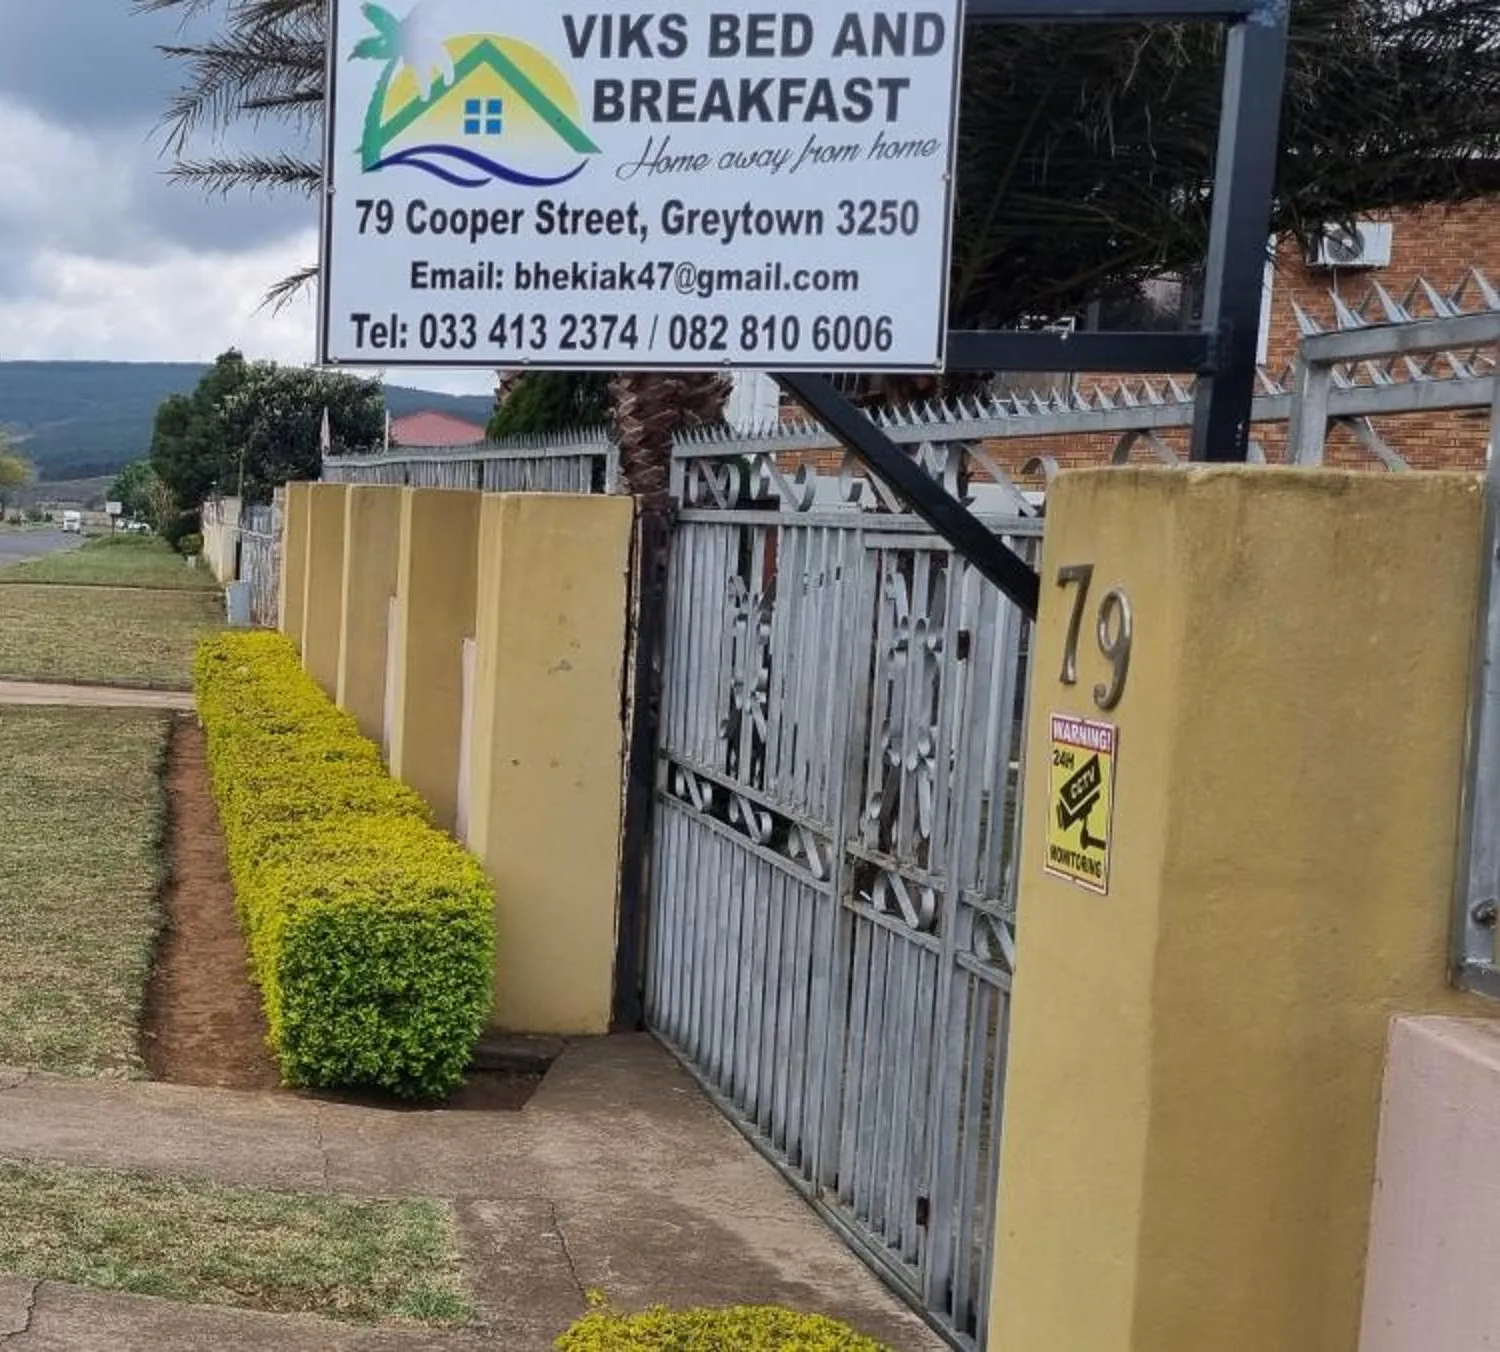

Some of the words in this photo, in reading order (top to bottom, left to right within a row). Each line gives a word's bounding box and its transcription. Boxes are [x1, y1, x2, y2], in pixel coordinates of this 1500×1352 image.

[563, 14, 689, 58] VIKS
[709, 14, 814, 57] BED
[832, 11, 945, 57] AND
[594, 78, 910, 122] BREAKFAST
[617, 136, 710, 179] Home
[718, 143, 790, 171] away
[789, 133, 859, 173] from
[871, 131, 940, 160] home
[356, 200, 394, 235] 79
[406, 200, 523, 242] Cooper
[535, 199, 648, 242] Street,
[661, 199, 823, 243] Greytown
[836, 200, 919, 236] 3250
[410, 261, 505, 290] Email:
[514, 261, 858, 298] bhekiak47@gmail.com
[351, 313, 407, 349] Tel:
[419, 313, 477, 349] 033
[489, 313, 547, 349] 413
[559, 313, 637, 350] 2374
[648, 313, 659, 350] /
[669, 313, 727, 351] 082
[740, 314, 800, 351] 810
[812, 314, 893, 351] 6006
[1056, 563, 1133, 710] 79
[1053, 719, 1111, 750] WARNING!
[1052, 750, 1075, 769] 24H
[1069, 765, 1096, 798] CCTV
[1050, 845, 1102, 878] MONITORING
